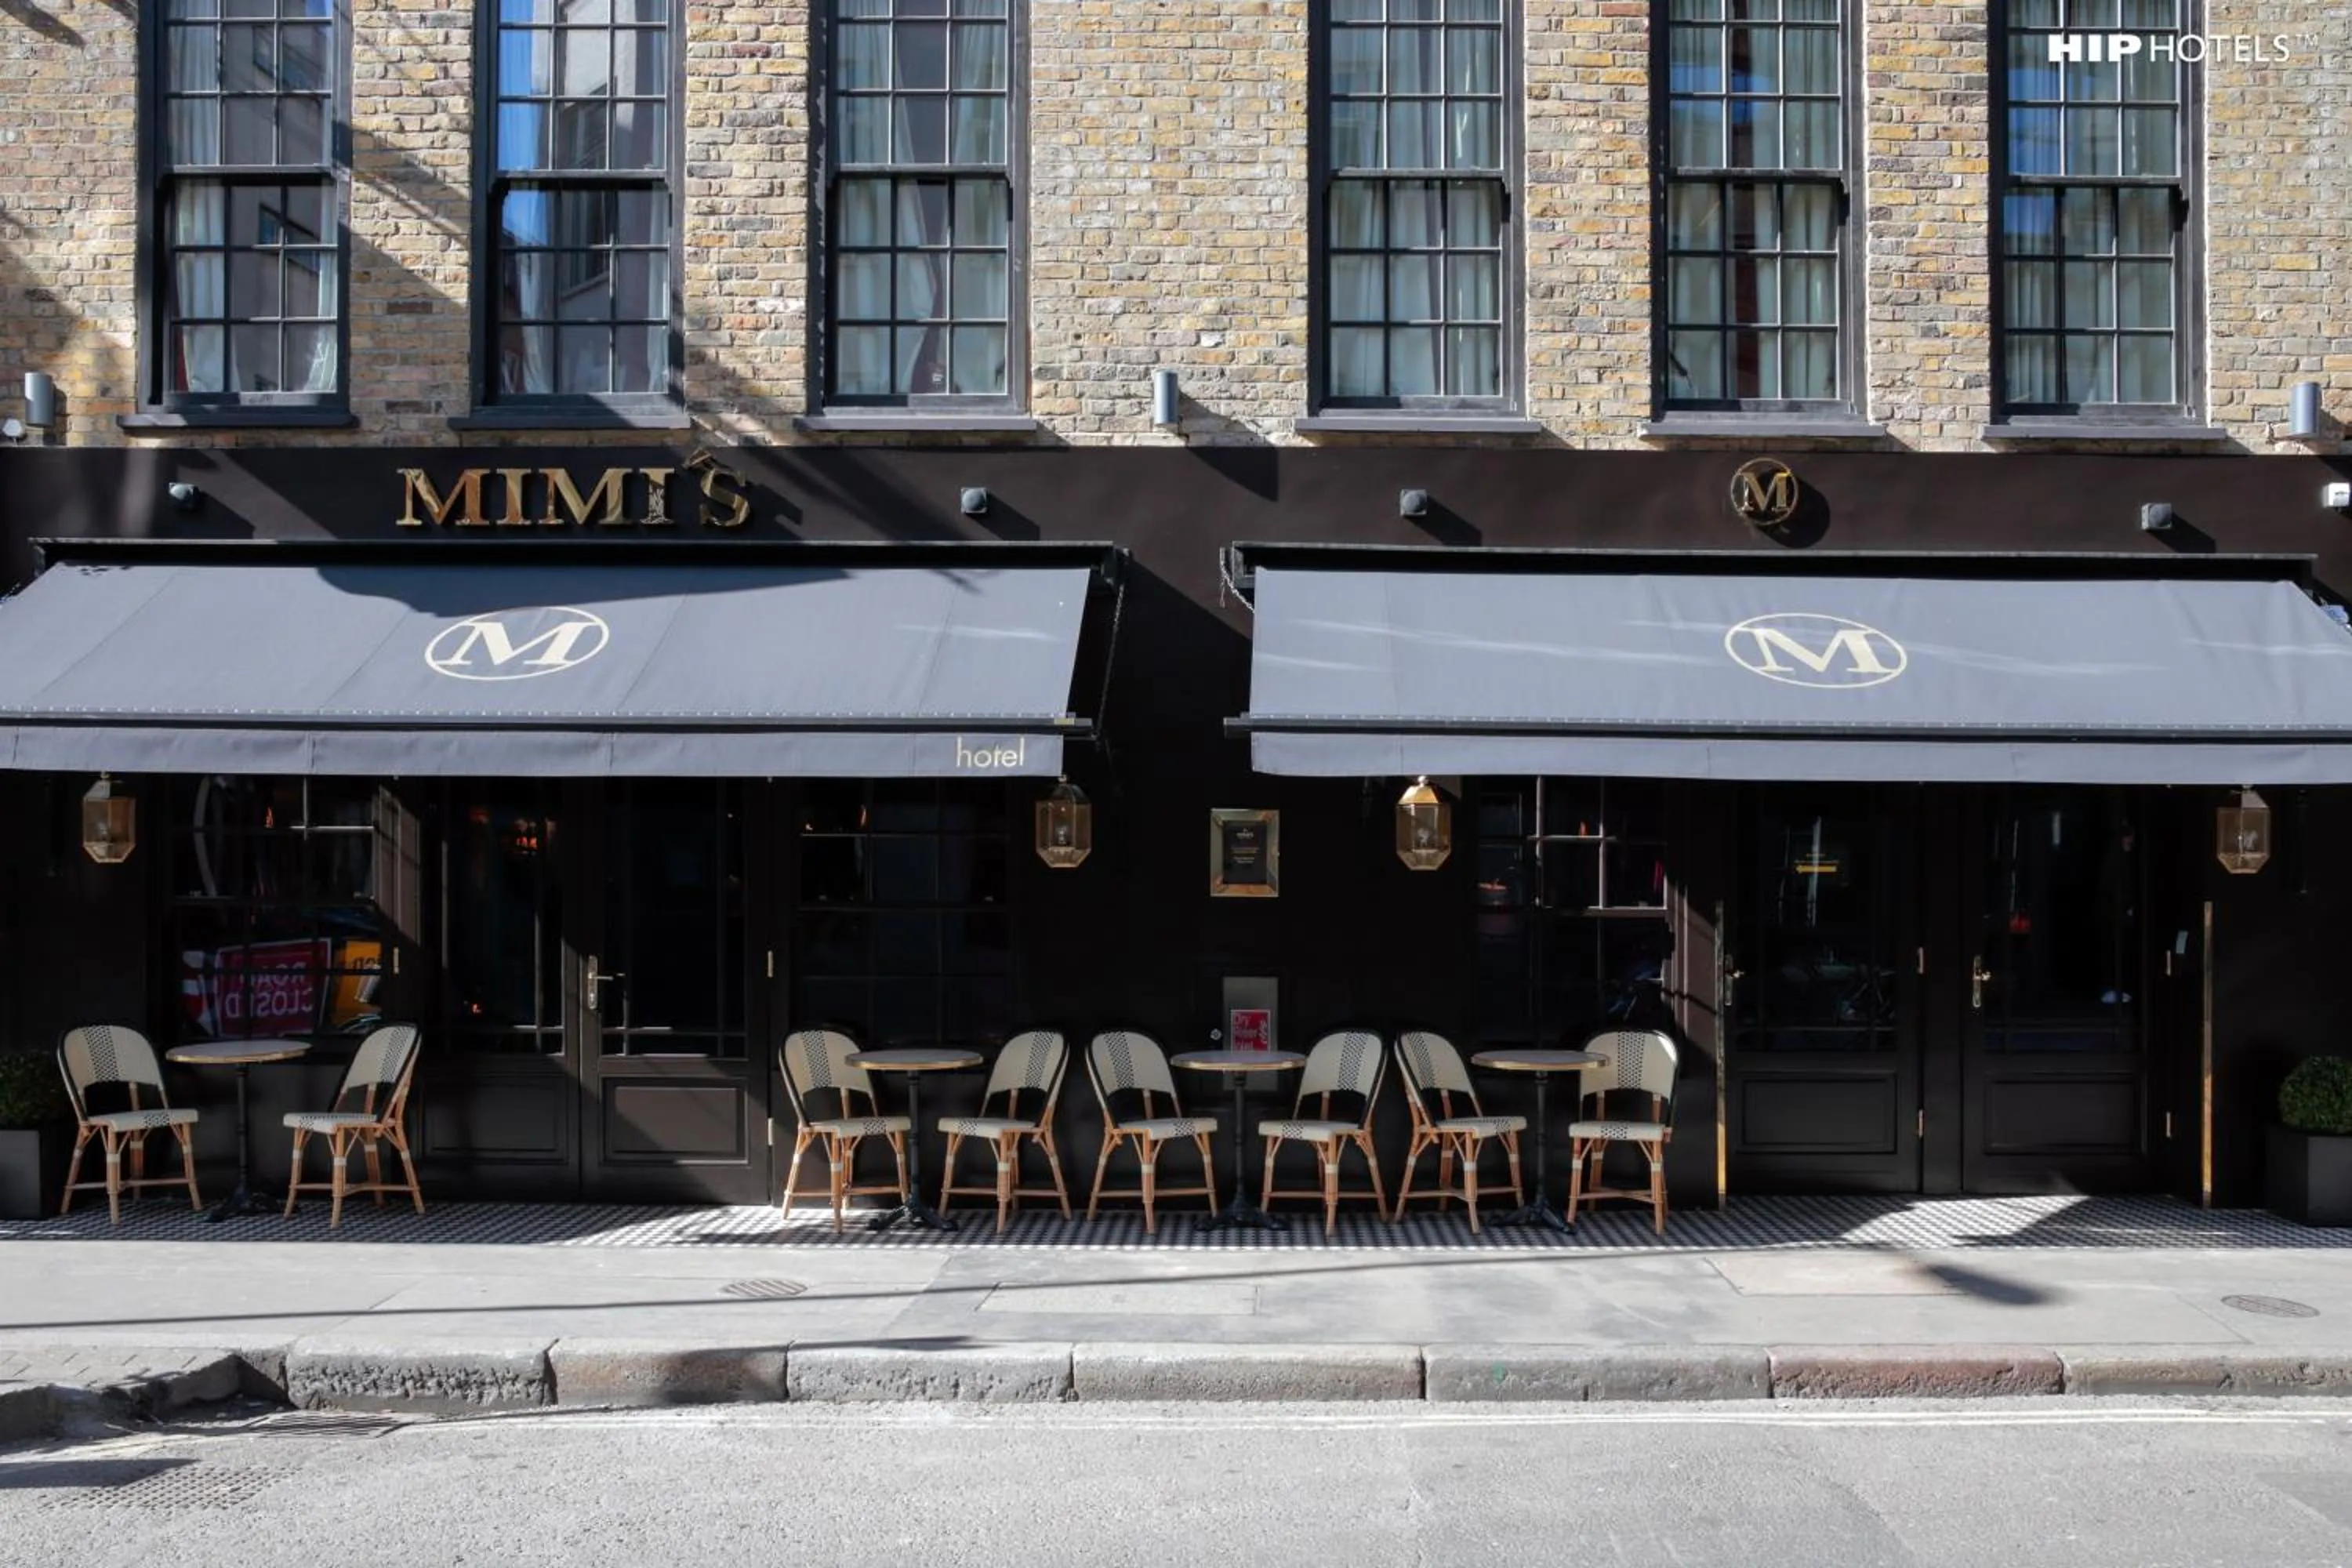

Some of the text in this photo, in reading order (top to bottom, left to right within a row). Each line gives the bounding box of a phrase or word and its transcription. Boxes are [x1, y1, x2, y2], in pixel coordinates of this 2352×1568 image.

[1734, 470, 1794, 514] M
[433, 620, 602, 666] M
[1733, 626, 1899, 673] M
[956, 735, 1025, 768] hotel
